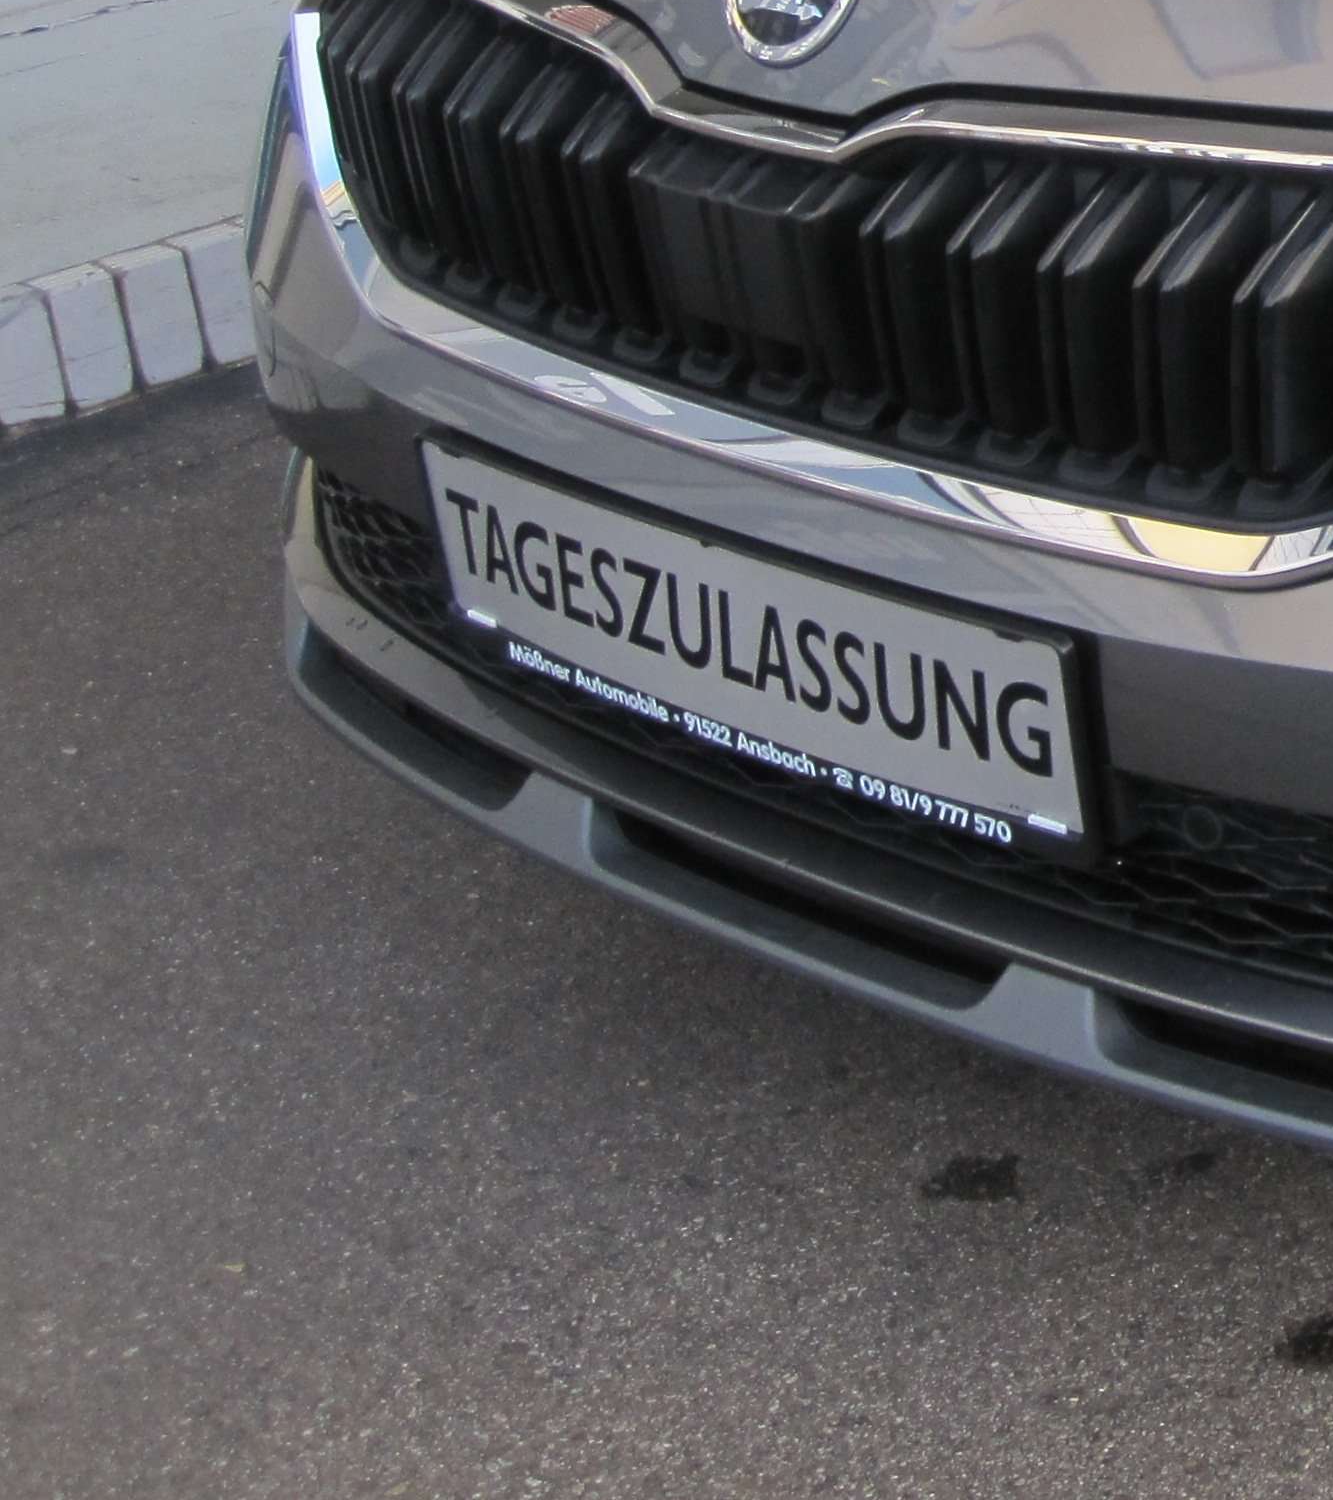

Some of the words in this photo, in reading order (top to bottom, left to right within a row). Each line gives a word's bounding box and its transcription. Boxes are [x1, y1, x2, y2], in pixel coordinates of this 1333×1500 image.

[445, 487, 1053, 778] TAGESZULASSUNG
[508, 640, 571, 682] Mößner
[575, 667, 669, 723] Automobile
[683, 710, 733, 748] 91522
[737, 730, 817, 778] Ansbach
[859, 774, 886, 801] 09
[973, 811, 1013, 845] 570
